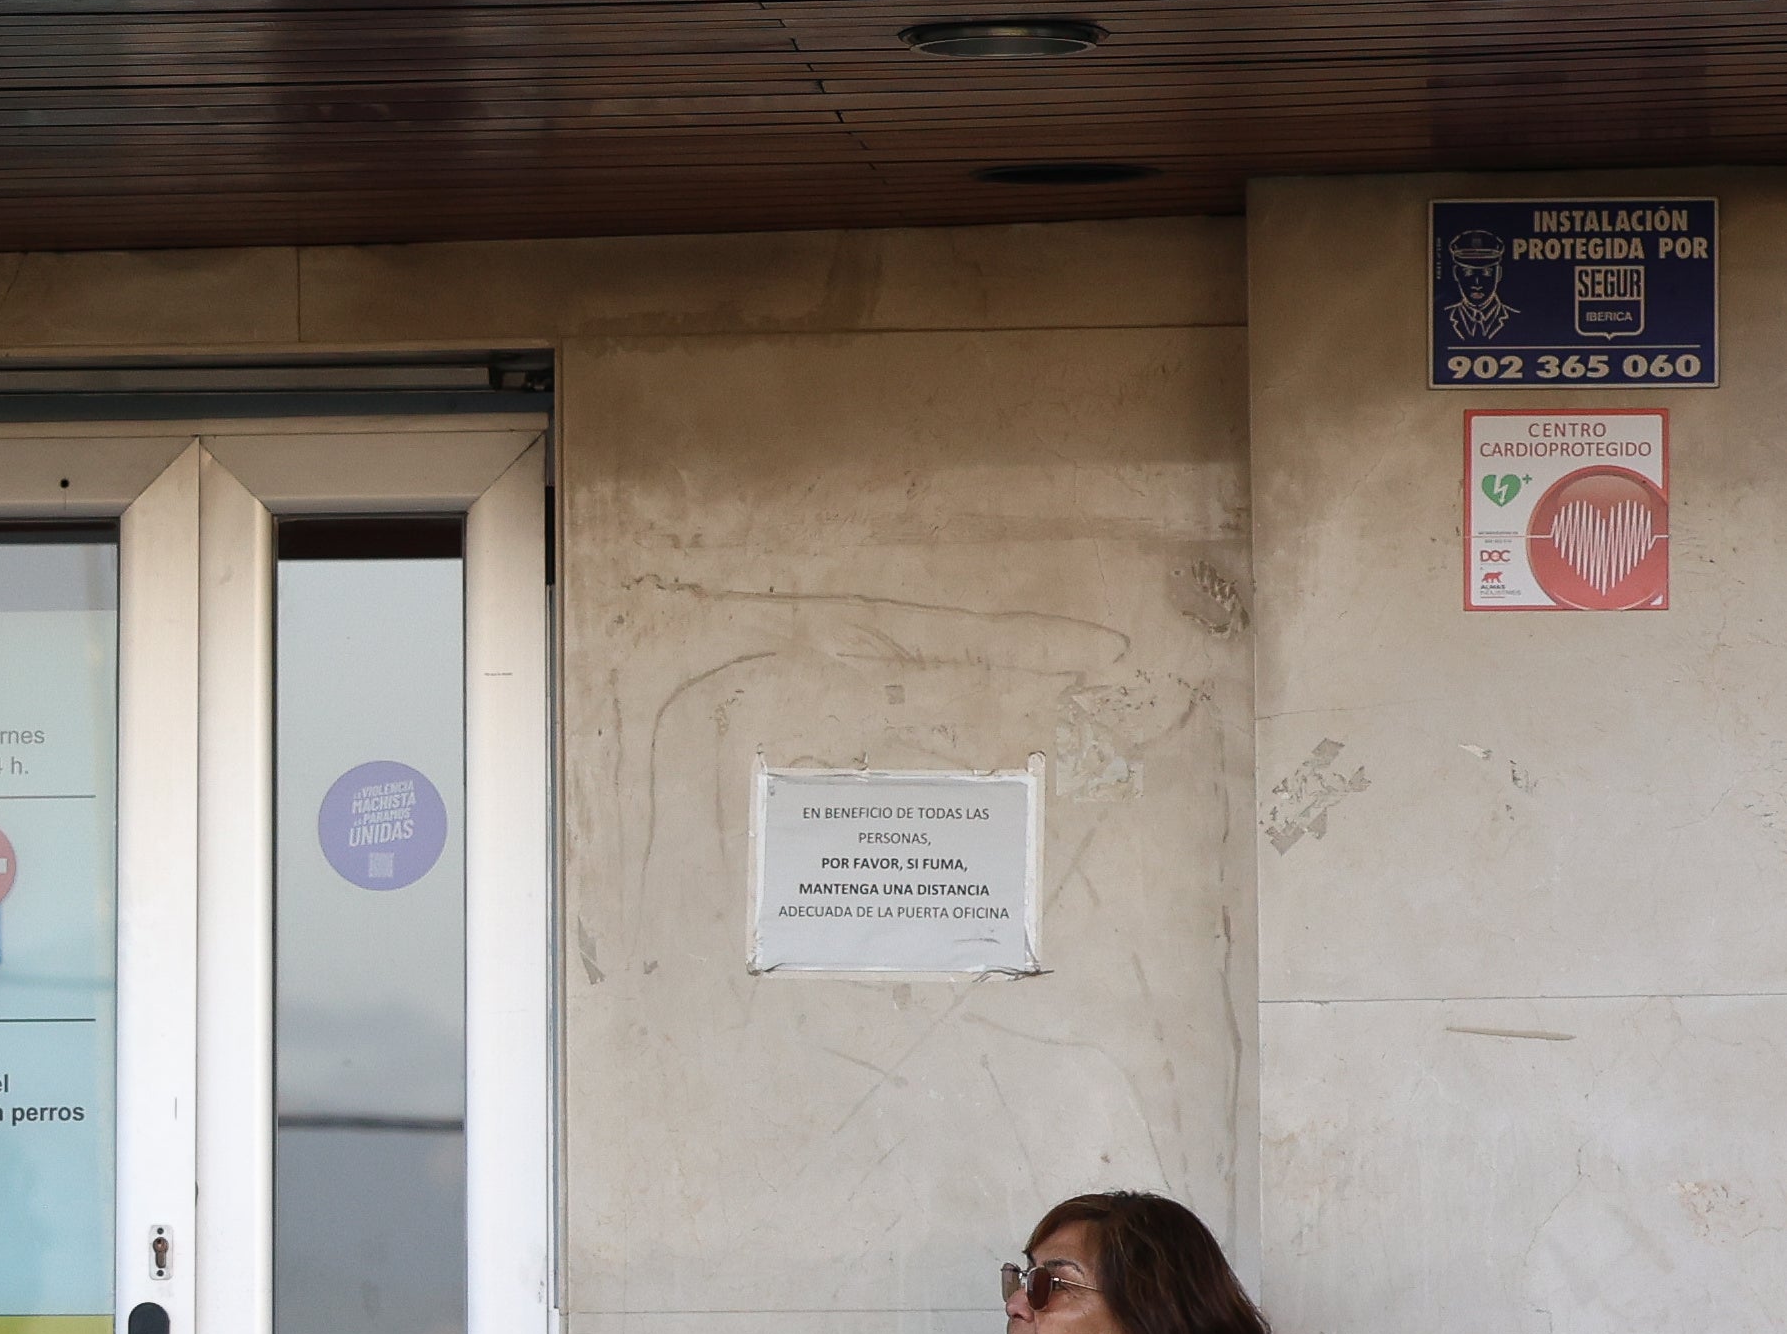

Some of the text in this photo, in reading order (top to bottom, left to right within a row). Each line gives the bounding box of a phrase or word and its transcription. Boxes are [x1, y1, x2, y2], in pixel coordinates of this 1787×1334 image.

[1533, 206, 1688, 233] INSTALACIÓN
[1512, 237, 1709, 260] PROTEGIDA POR
[1578, 268, 1641, 298] SEGUR
[1586, 311, 1633, 322] IBERICA
[1447, 354, 1701, 379] 902 365 060
[1528, 422, 1607, 438] CENTRO
[1480, 441, 1652, 458] CARDIOPROTEGIDO
[11, 757, 29, 775] h.
[353, 791, 416, 814] MACHISTA
[803, 807, 989, 820] EN BENEFICIO DE TODAS LAS
[349, 819, 415, 847] UNIDAS
[858, 833, 931, 846] PERSONAS,
[822, 858, 968, 872] POR FAVOR, SI FUMA,
[799, 884, 989, 896] MANTENGA UNA DISTANCIA
[779, 906, 1009, 919] ADECUADA DE LA PUERTA OFICINA
[12, 1106, 85, 1126] perros
